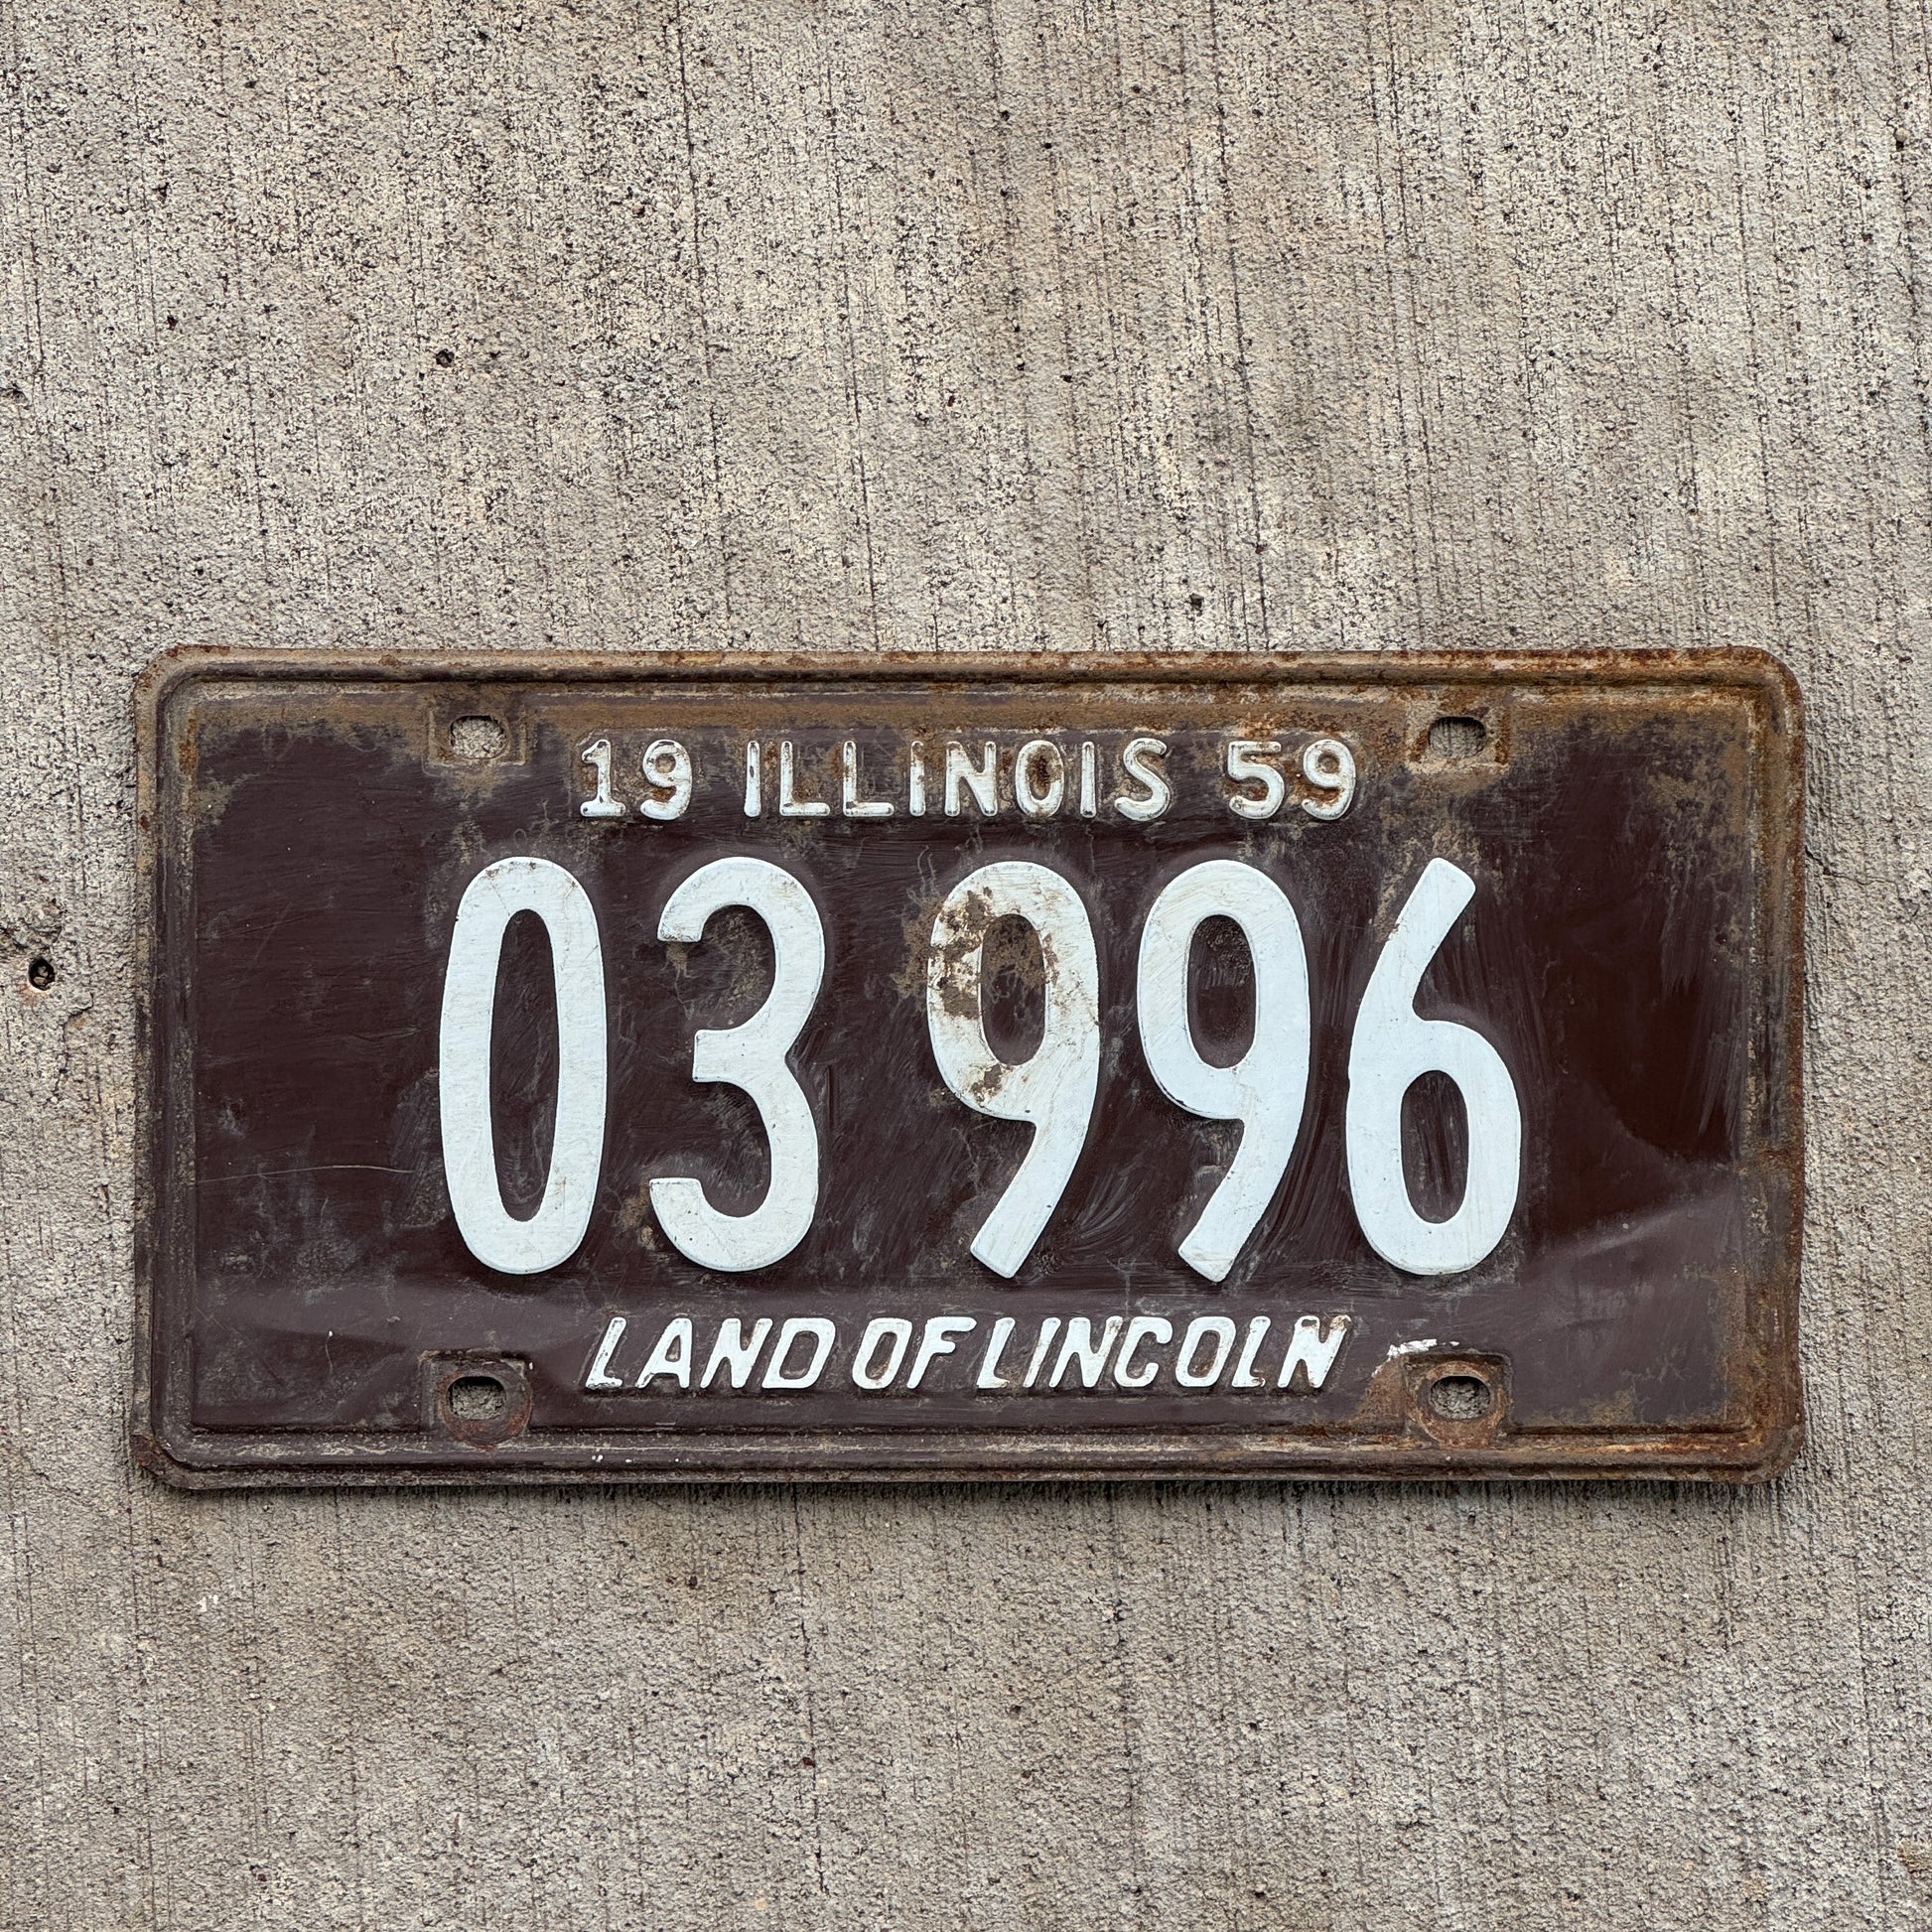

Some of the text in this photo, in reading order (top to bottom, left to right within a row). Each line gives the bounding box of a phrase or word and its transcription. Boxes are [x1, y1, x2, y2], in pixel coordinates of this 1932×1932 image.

[581, 738, 1357, 822] 19 ILLINOIS 59
[439, 856, 1523, 1282] 03 996
[586, 1314, 1351, 1390] LAND OF LINCOLN
